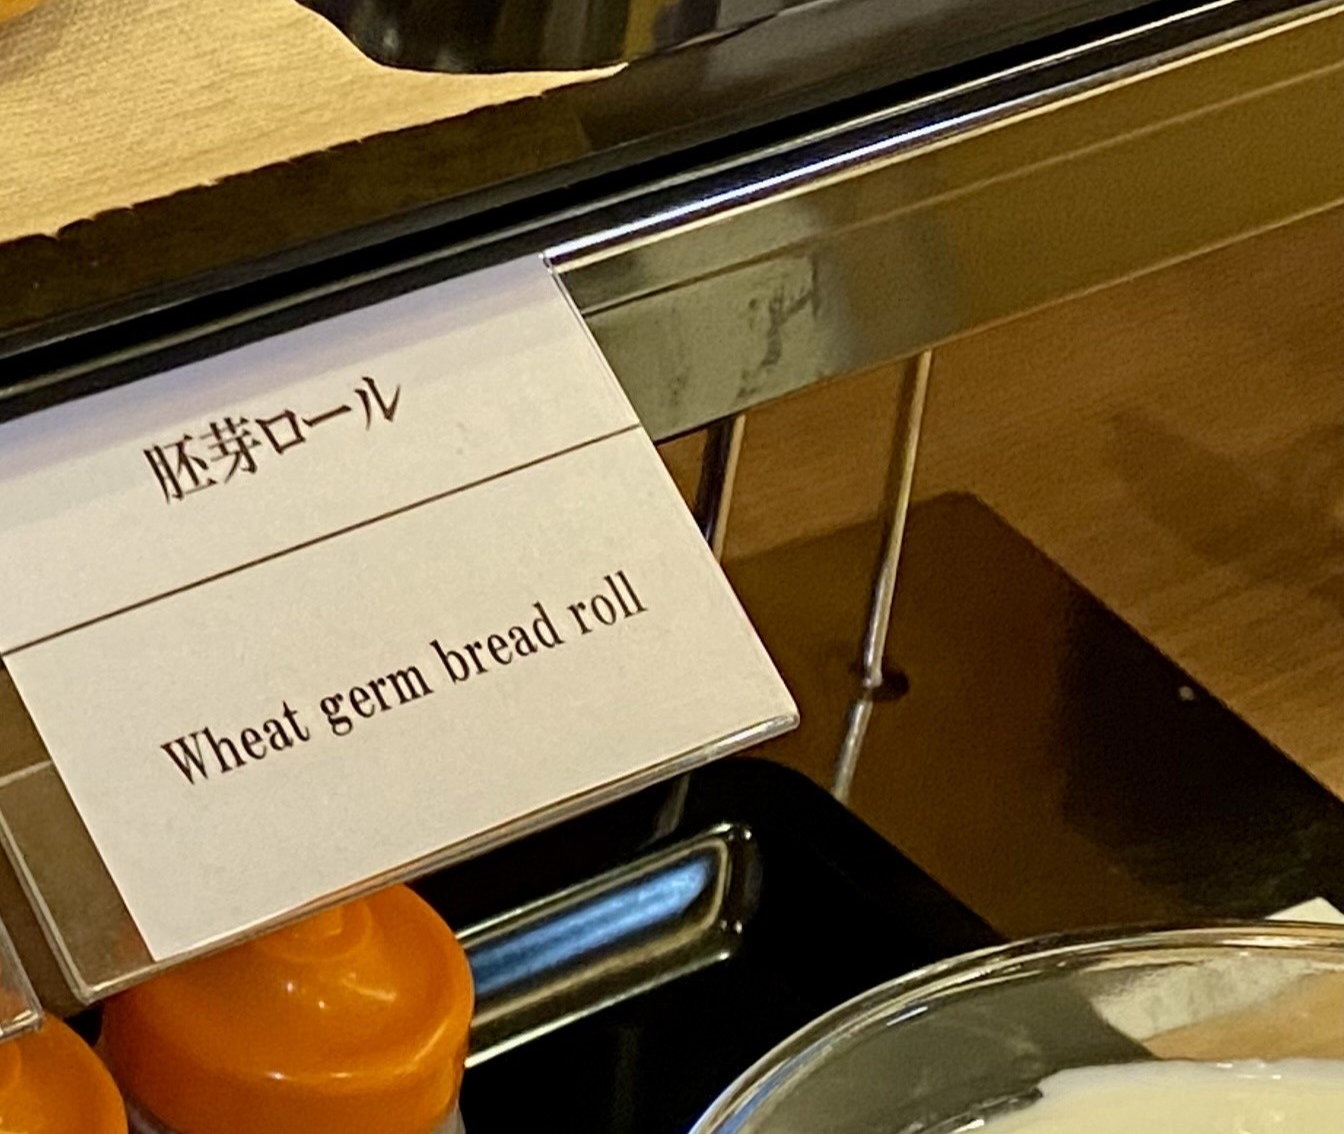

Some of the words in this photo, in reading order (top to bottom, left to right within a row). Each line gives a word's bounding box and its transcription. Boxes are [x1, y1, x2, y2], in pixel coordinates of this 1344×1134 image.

[142, 375, 401, 503] 胚芽ロール
[159, 700, 311, 786] Wheat
[319, 665, 435, 738] germ
[429, 600, 565, 684] bread
[566, 569, 647, 636] roll
